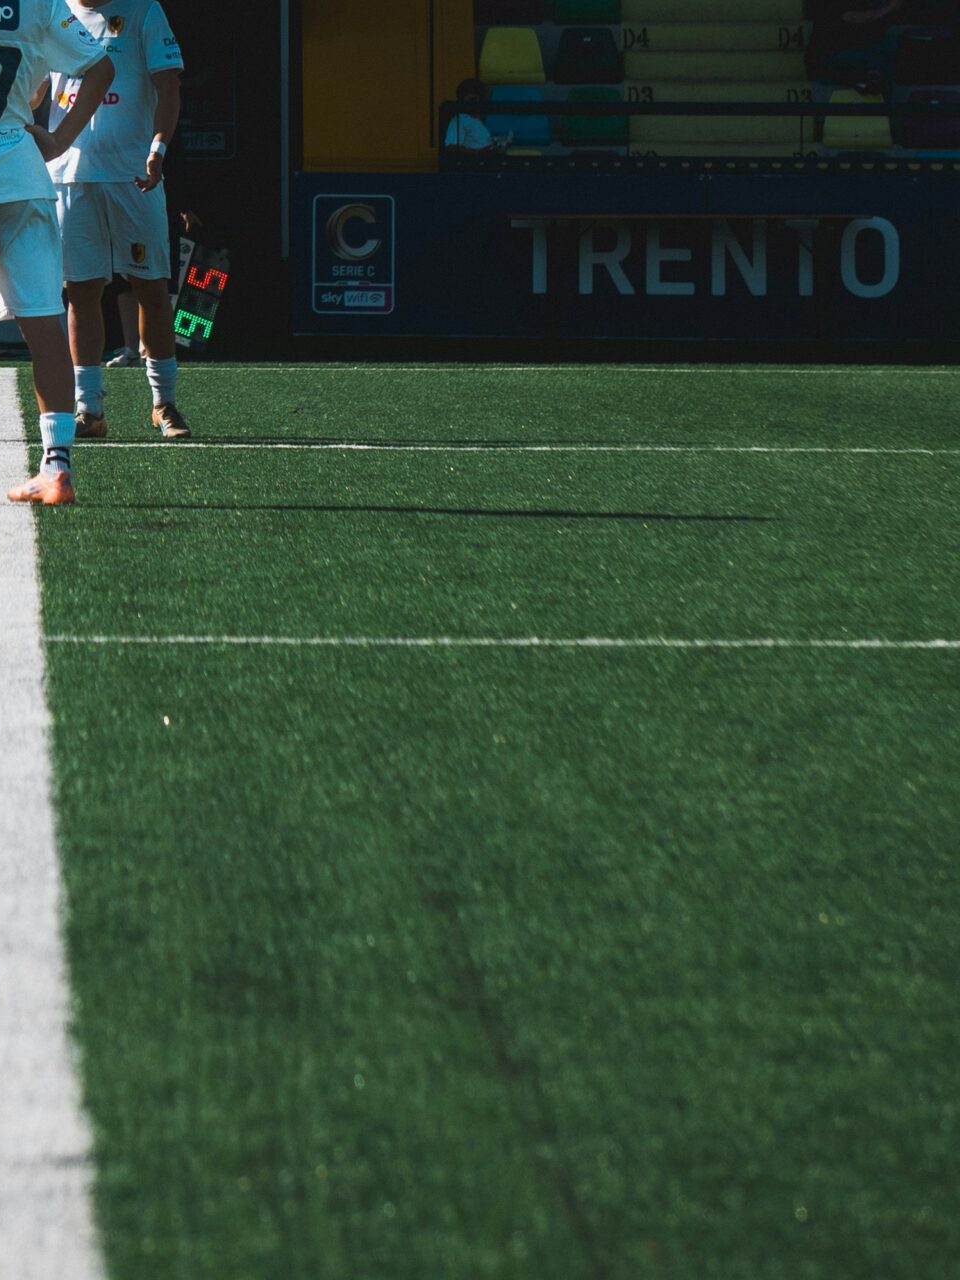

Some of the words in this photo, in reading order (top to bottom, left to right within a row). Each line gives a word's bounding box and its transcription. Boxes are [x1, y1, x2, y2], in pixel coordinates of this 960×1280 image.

[623, 28, 650, 49] D4
[778, 26, 803, 49] D4
[509, 215, 902, 299] TRENTO
[331, 265, 365, 278] SERIE
[367, 265, 376, 278] C
[320, 291, 343, 306] sky
[346, 291, 368, 304] wifi
